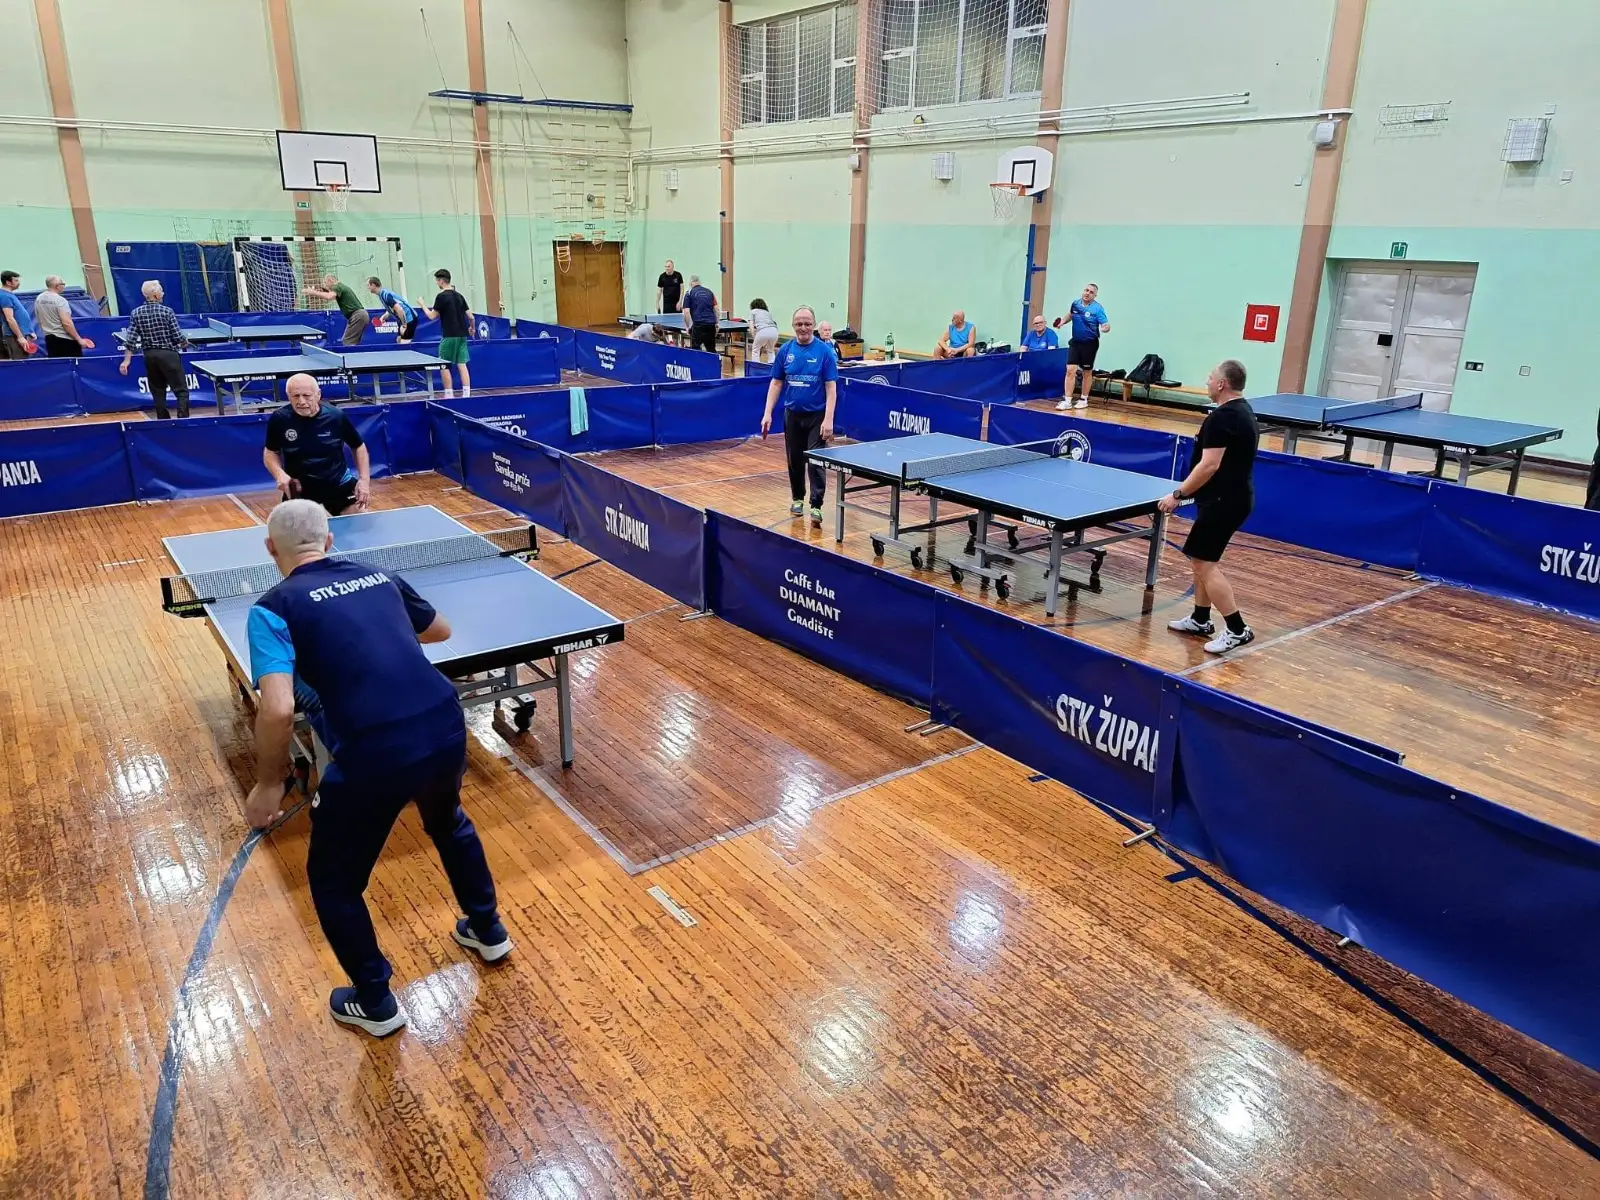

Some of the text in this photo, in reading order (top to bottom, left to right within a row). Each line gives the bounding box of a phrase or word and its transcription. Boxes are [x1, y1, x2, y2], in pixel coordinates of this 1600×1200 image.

[888, 407, 930, 435] STK ŽUPANJA
[0, 460, 42, 487] ANJA
[604, 502, 650, 552] STK ŽUPANJA
[1022, 514, 1046, 528] TIBHAR
[1540, 541, 1600, 584] STK ŽU
[309, 572, 391, 602] STK ŽUPANJA
[779, 585, 842, 622] DIJAMANT
[552, 638, 593, 655] TIBHAR
[1056, 693, 1095, 746] STK
